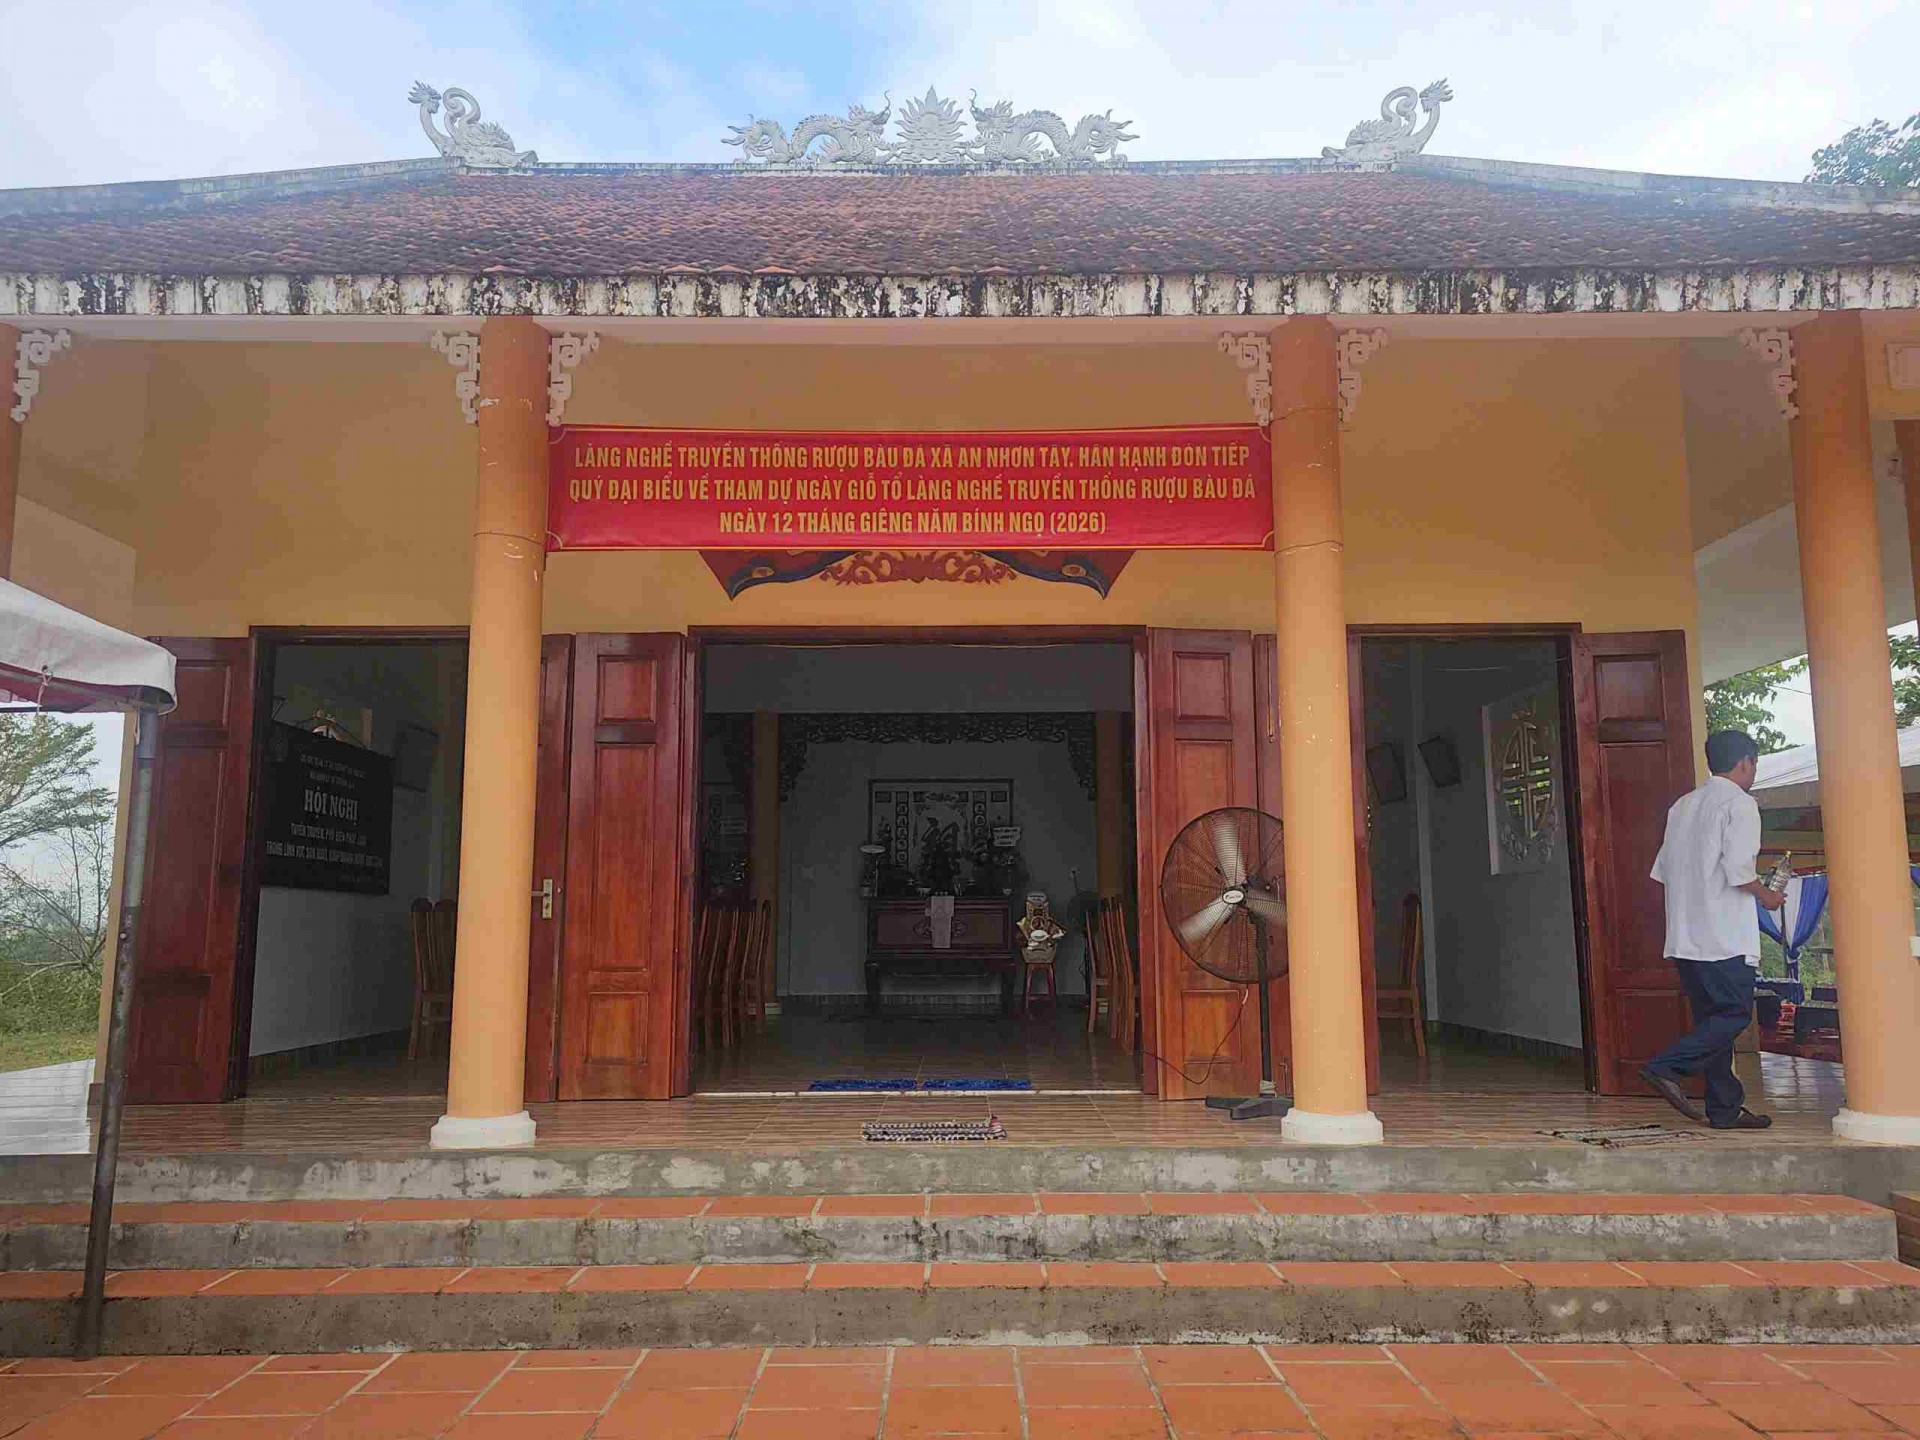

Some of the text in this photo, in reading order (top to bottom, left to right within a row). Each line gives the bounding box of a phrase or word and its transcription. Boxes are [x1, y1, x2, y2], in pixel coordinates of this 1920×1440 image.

[575, 442, 621, 468] LÀNG
[749, 440, 808, 468] THỐNG
[812, 445, 859, 473] RƯỢU
[863, 443, 898, 468] BÀU
[903, 443, 926, 468] ĐÁ
[931, 444, 953, 468] XÃ
[958, 446, 981, 468] AN
[986, 445, 1035, 468] NHƠN
[1119, 446, 1166, 472] HẠNH
[1212, 440, 1249, 466] TIẾP
[569, 475, 604, 503] QUÝ
[608, 479, 637, 505] ĐẠI
[643, 471, 684, 500] BIỂU
[714, 479, 763, 500] THAM
[768, 478, 793, 505] DỰ
[797, 475, 843, 500] NGÀY
[847, 472, 877, 500] GIỖ
[881, 472, 903, 500] TỔ
[907, 475, 952, 500] LÀNG
[1079, 471, 1136, 500] THỐNG
[1141, 476, 1188, 504] RƯỢU
[1192, 474, 1227, 499] BÀU
[1232, 474, 1256, 499] ĐÁ
[720, 507, 1106, 539] NGÀY 12 THÁNG GIÊNG NĂM BÍNH NGỌ (2026)
[304, 786, 358, 826] HỘI NGHỊ
